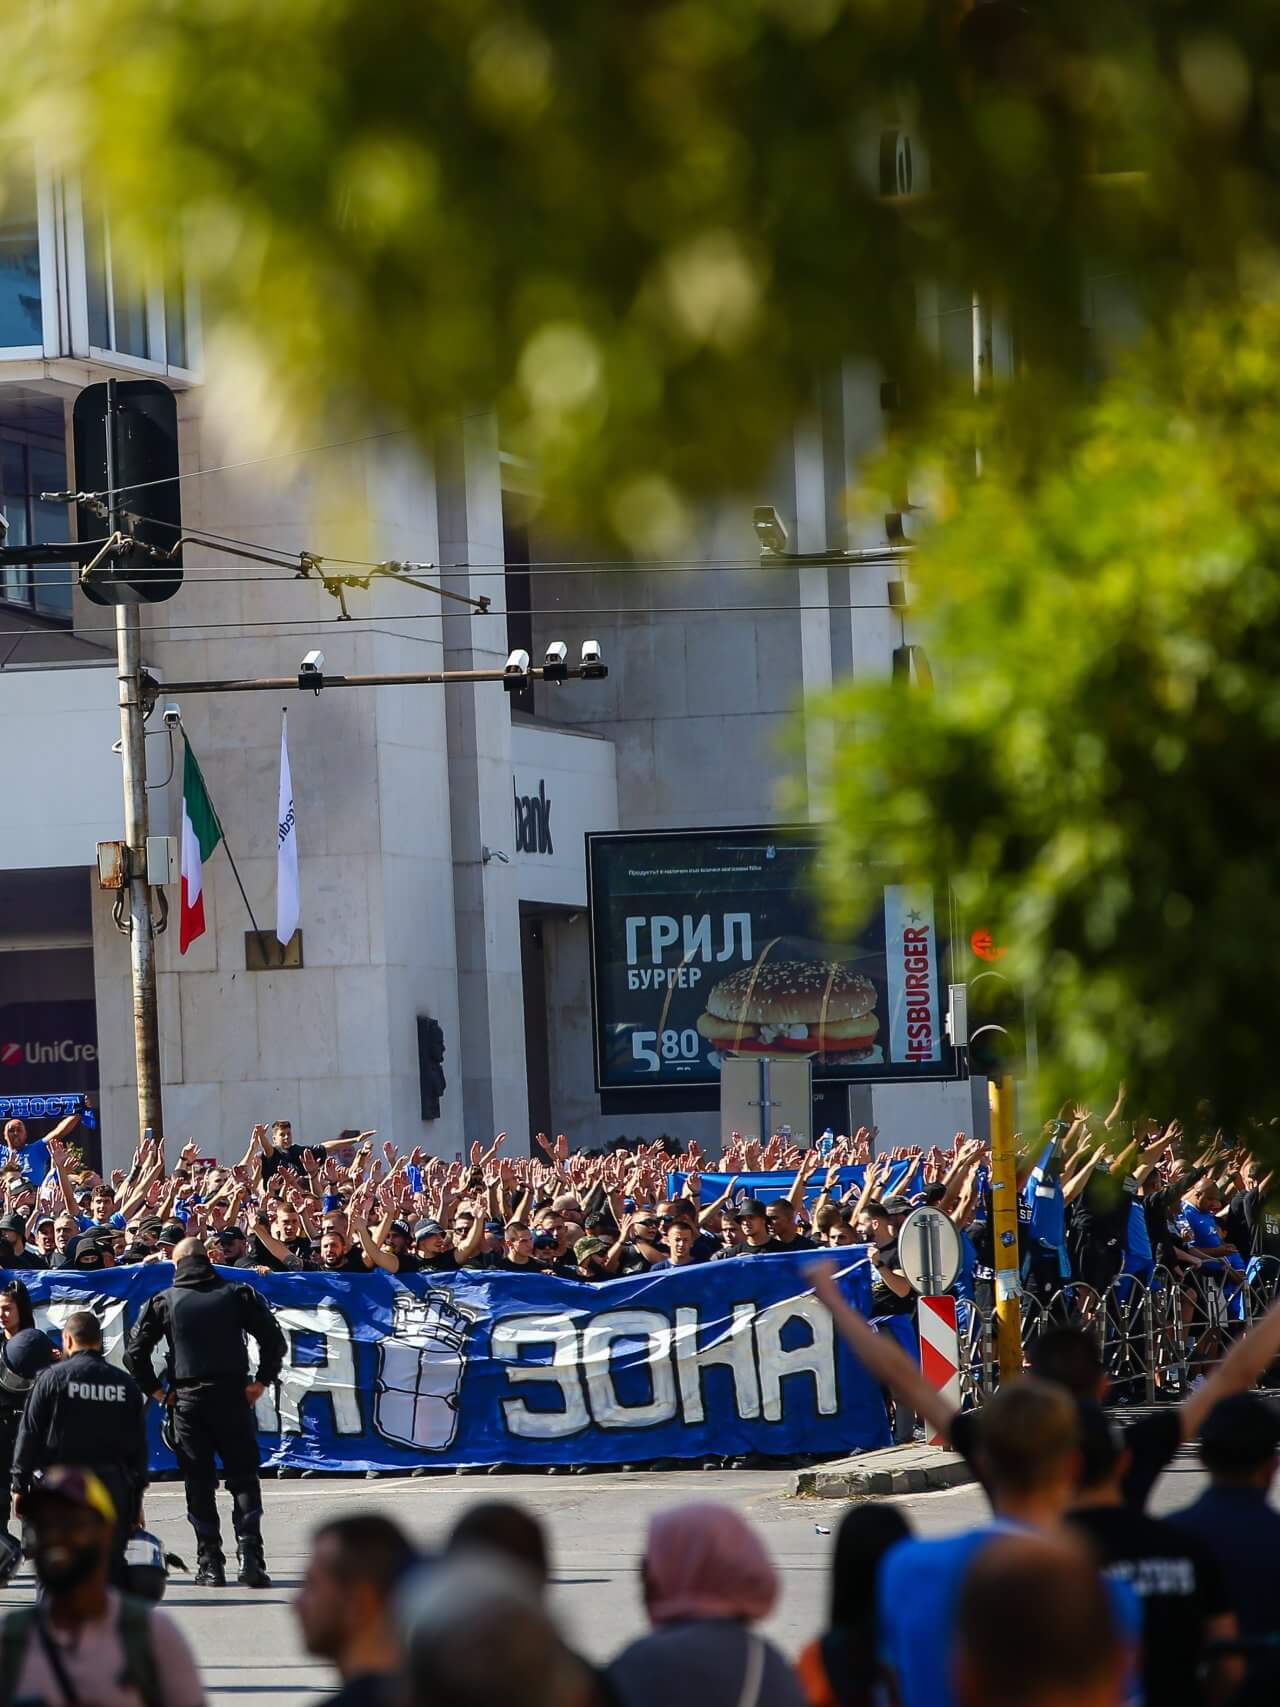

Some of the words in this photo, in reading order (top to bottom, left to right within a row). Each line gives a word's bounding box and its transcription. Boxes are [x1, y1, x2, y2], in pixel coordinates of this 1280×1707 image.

[625, 912, 753, 966] ГРИЛ
[628, 967, 701, 990] БУРГЕР
[490, 1295, 838, 1439] ЗОНА
[68, 1381, 126, 1402] POLICE
